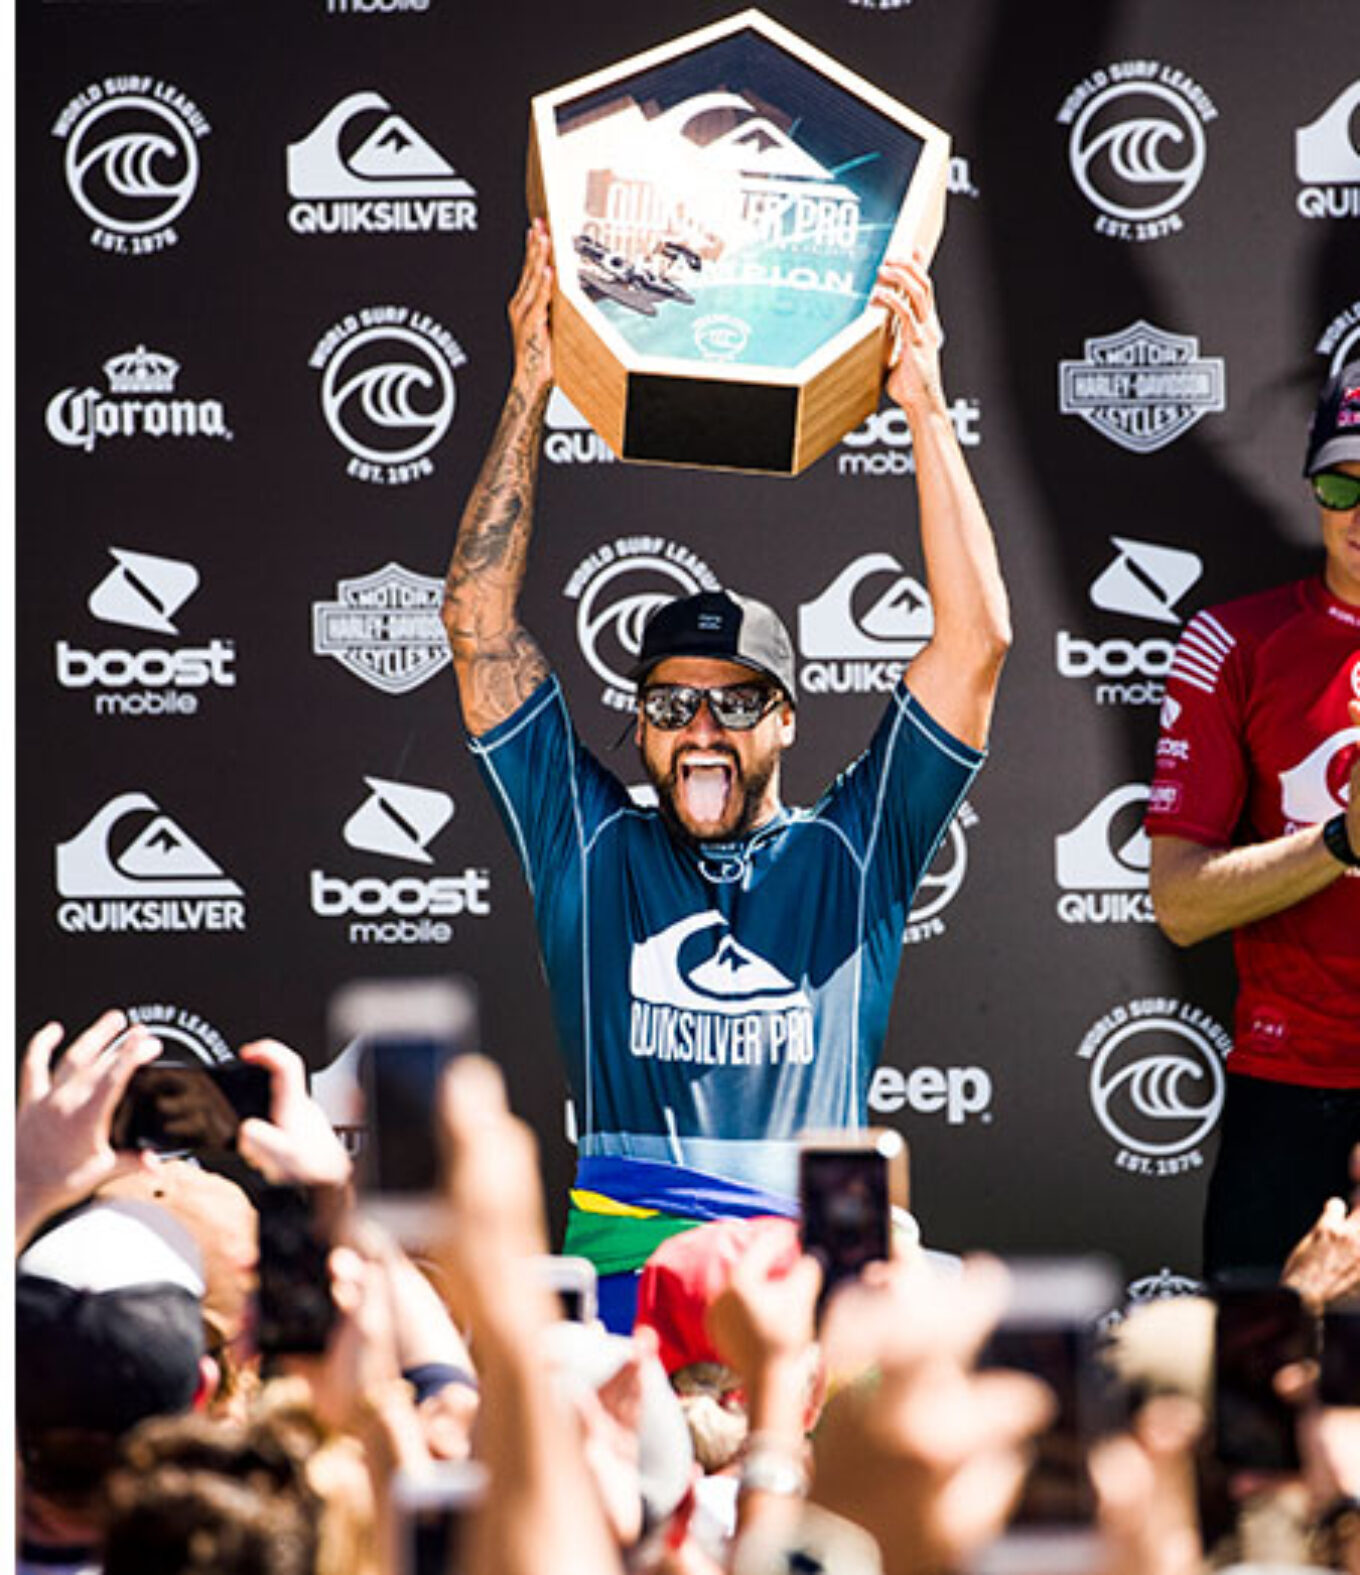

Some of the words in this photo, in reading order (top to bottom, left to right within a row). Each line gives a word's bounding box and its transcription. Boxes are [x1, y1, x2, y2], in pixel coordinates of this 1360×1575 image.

[51, 84, 103, 137] WORLD
[103, 75, 153, 95] SURF
[153, 81, 212, 139] LEAGUE
[1056, 70, 1108, 123] WORLD
[1108, 61, 1158, 81] SURF
[1159, 65, 1219, 122] LEAGUE
[287, 200, 478, 233] QUIKSILVER
[308, 314, 359, 368] WORLD
[359, 305, 408, 326] SURF
[409, 311, 468, 368] LEAGUE
[564, 544, 615, 598] WORLD
[615, 535, 665, 557] SURF
[56, 639, 236, 687] boost
[801, 661, 909, 692] QUIKS
[1057, 630, 1175, 678] boo
[96, 692, 197, 715] mobile
[57, 900, 244, 933] QUIKSILVER
[310, 869, 490, 917] boost
[349, 922, 452, 945] mobile
[128, 1003, 176, 1023] SURF
[177, 1009, 235, 1064] LEAGUE
[1077, 1006, 1128, 1058] WORLD
[1129, 998, 1179, 1016] SURF
[868, 1065, 993, 1123] eep
